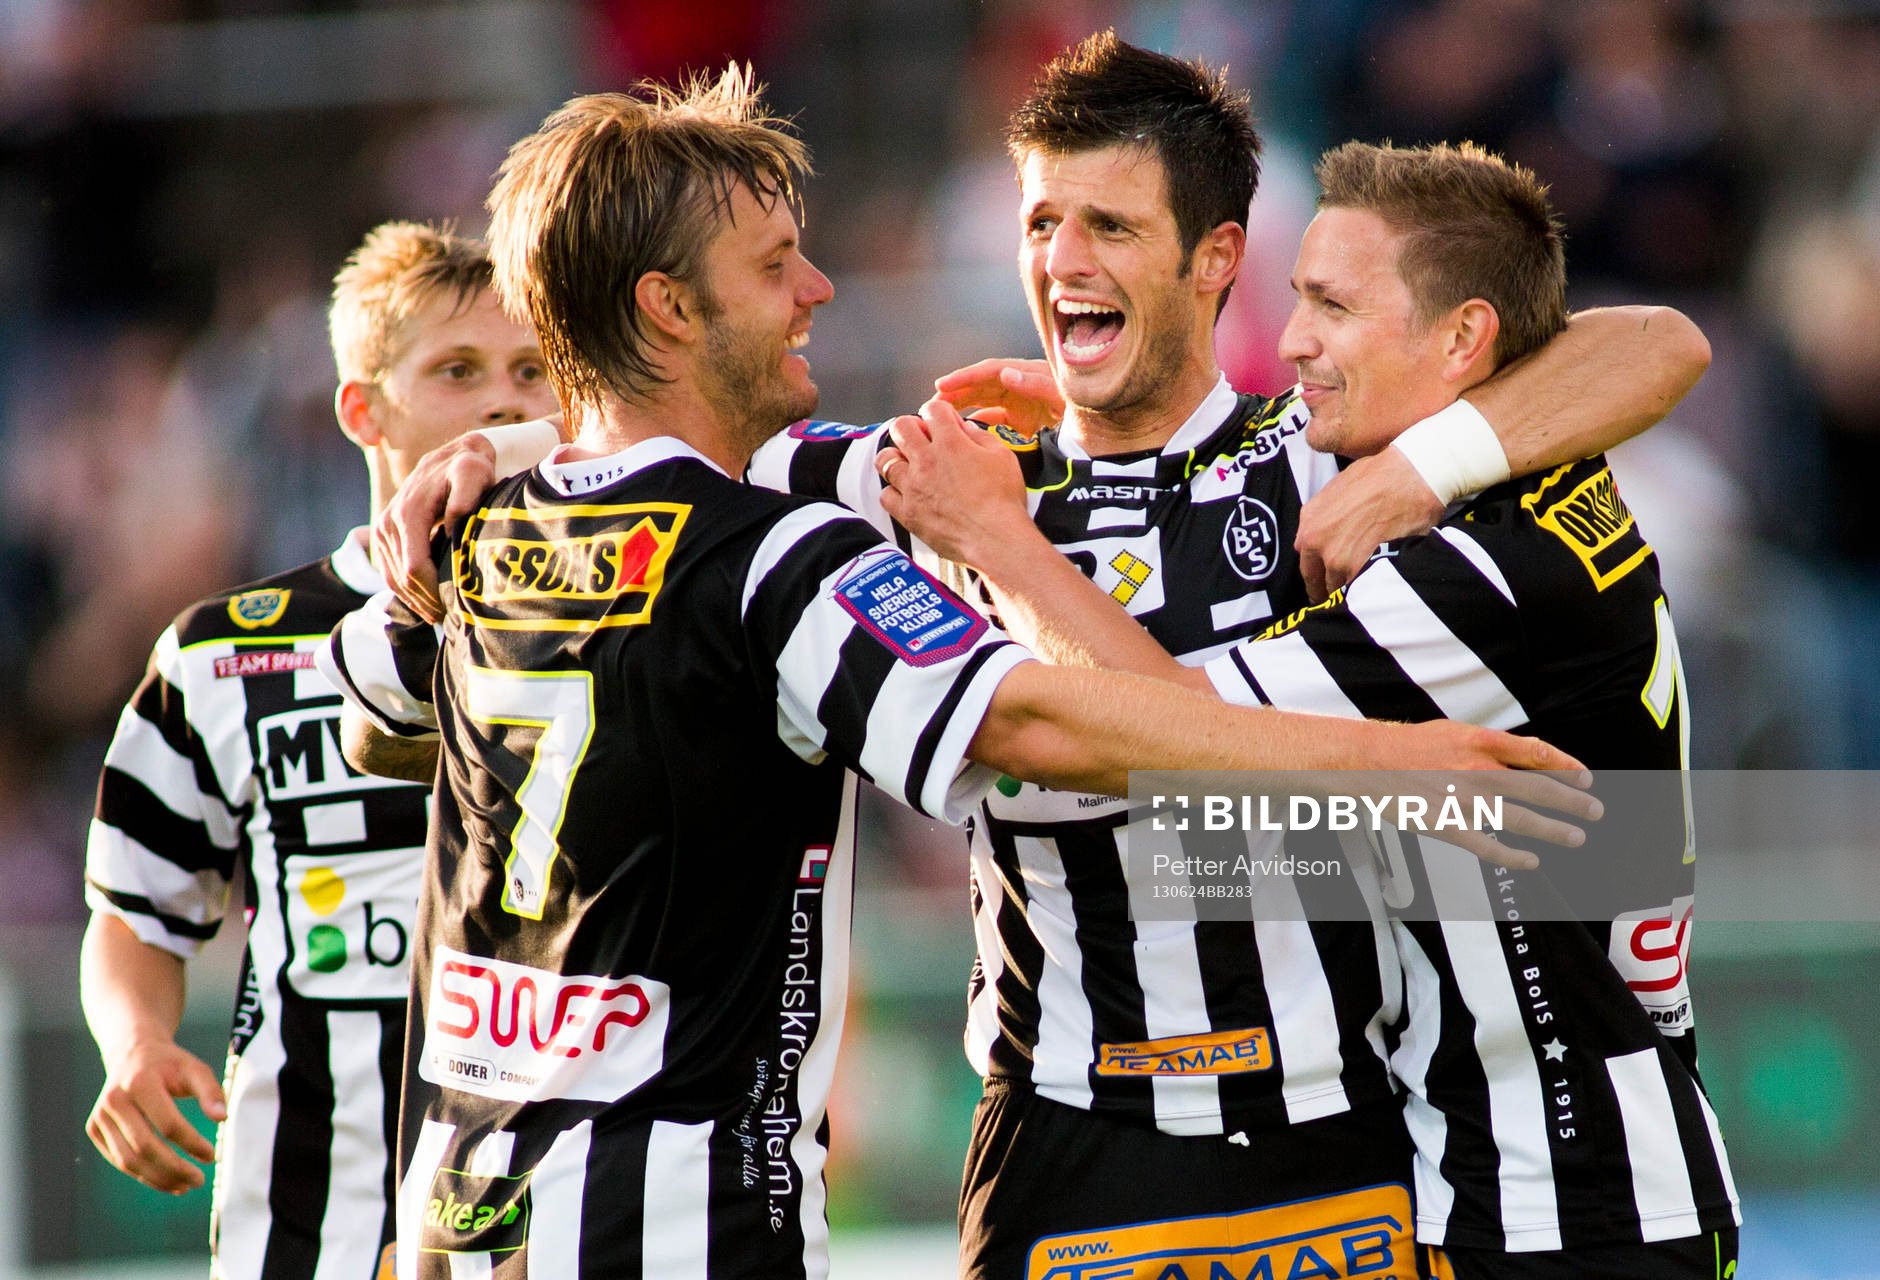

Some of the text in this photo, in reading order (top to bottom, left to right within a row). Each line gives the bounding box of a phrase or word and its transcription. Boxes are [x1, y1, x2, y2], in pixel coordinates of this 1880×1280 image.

[584, 466, 625, 488] 1915
[868, 581, 930, 620] SVERIGES
[870, 576, 907, 601] HELA
[877, 593, 942, 631] FOTBOLLS
[899, 608, 943, 634] KLUBB
[214, 654, 270, 675] TEAM
[466, 670, 596, 921] 7
[437, 960, 651, 1058] SWEP
[448, 1060, 488, 1080] DOVER
[761, 887, 822, 1234] Landskronahem.se
[1554, 1077, 1577, 1140] 1915
[743, 1153, 760, 1189] alla
[1041, 1229, 1395, 1280] MAB
[1047, 1239, 1115, 1261] www.
